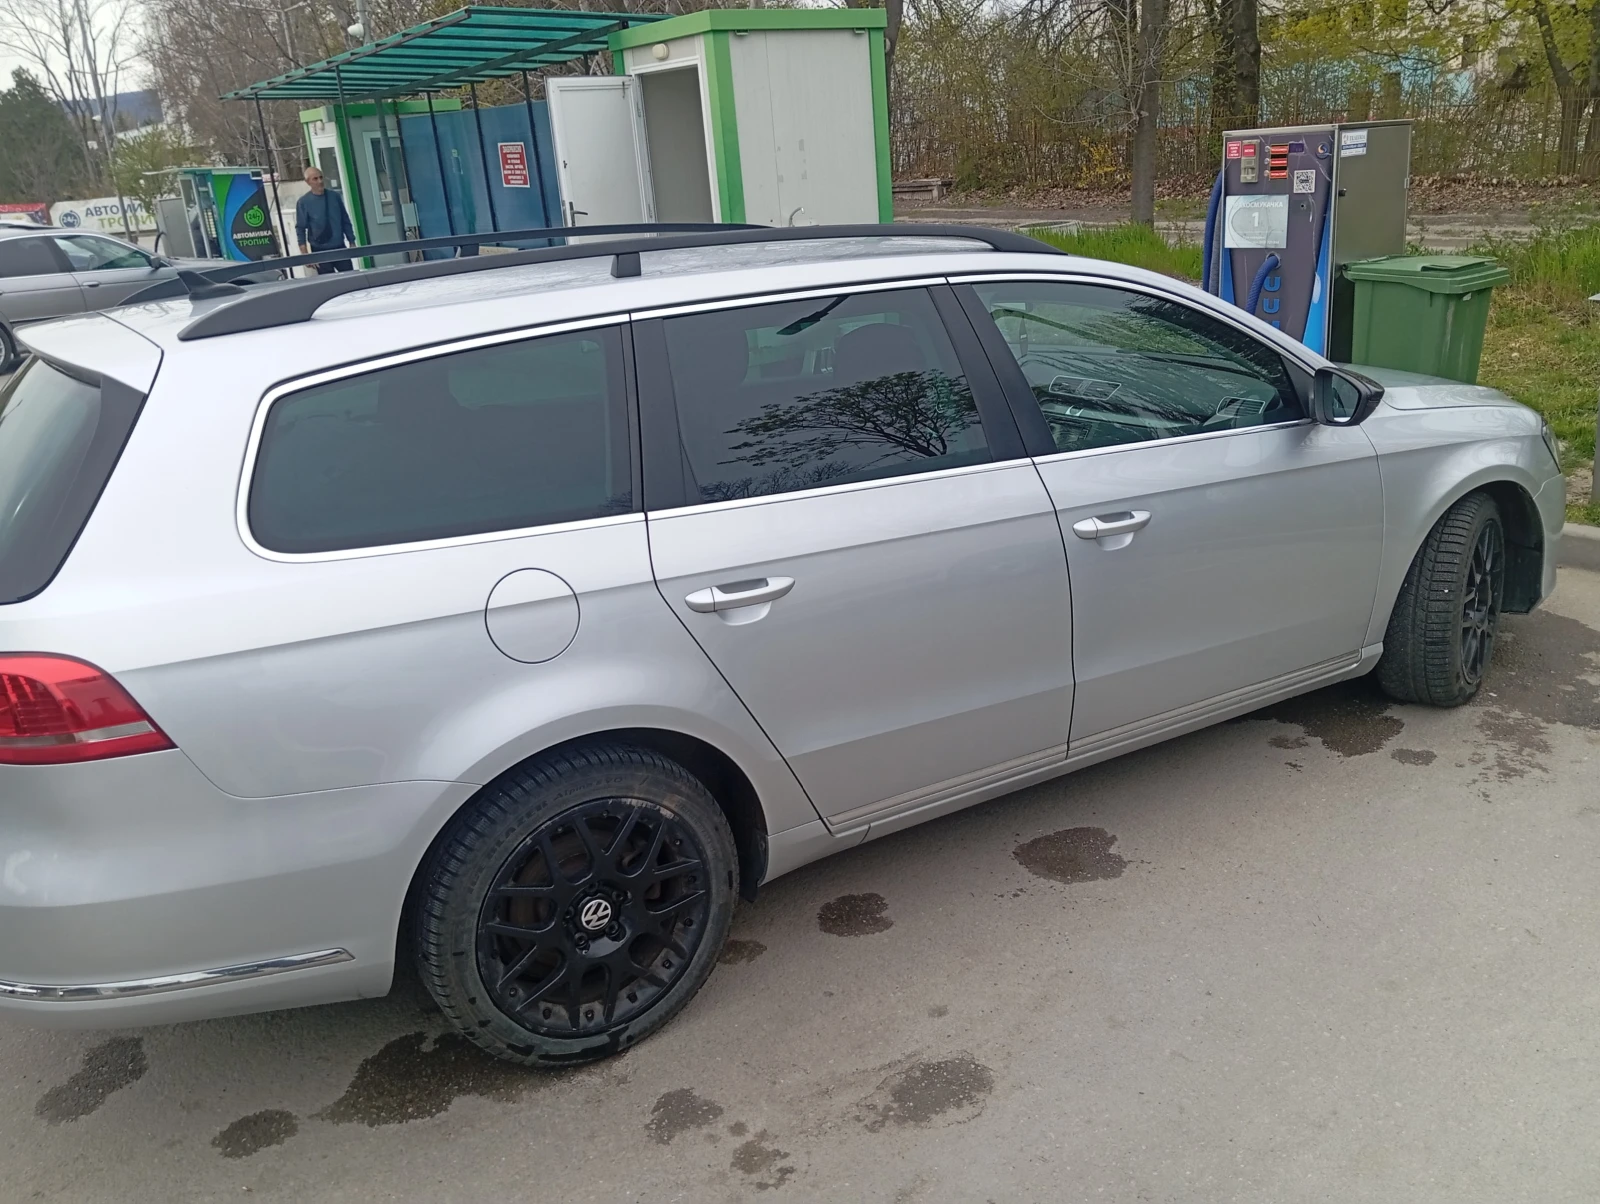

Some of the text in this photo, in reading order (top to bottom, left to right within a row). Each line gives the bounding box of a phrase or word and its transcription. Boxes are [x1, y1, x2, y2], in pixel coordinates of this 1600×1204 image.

[84, 203, 143, 217] АВТОМИ
[97, 214, 153, 229] ТРОПИ
[1252, 211, 1259, 227] 1
[233, 230, 272, 239] АВТОМИВКА
[238, 238, 270, 247] ТРОПИК
